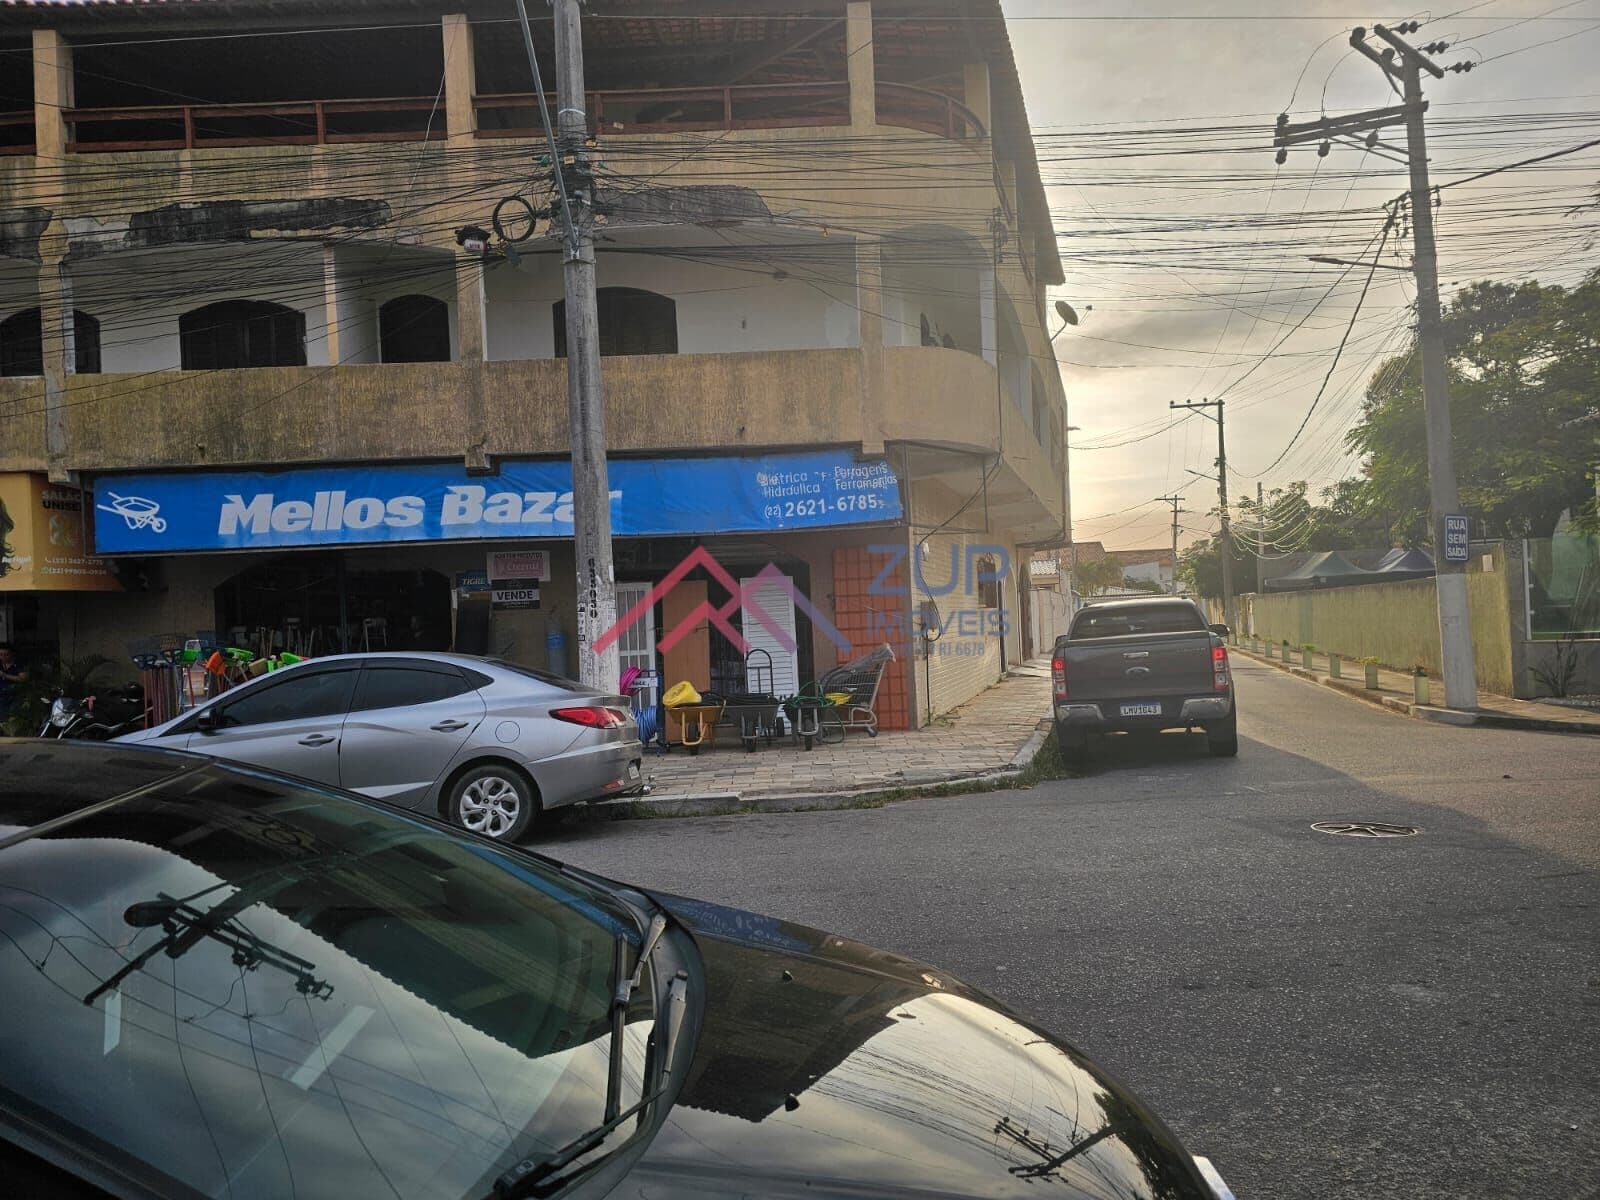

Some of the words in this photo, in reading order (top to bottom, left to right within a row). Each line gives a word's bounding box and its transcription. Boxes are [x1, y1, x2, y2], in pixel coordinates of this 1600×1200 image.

[43, 501, 81, 512] UNISE
[764, 504, 782, 519] (22)
[785, 494, 878, 517] 2621-6785
[218, 490, 425, 535] Mellos
[1448, 519, 1466, 530] RUA
[1448, 534, 1466, 544] SEM
[1447, 545, 1466, 557] SAÍDA
[497, 590, 533, 601] VENDE
